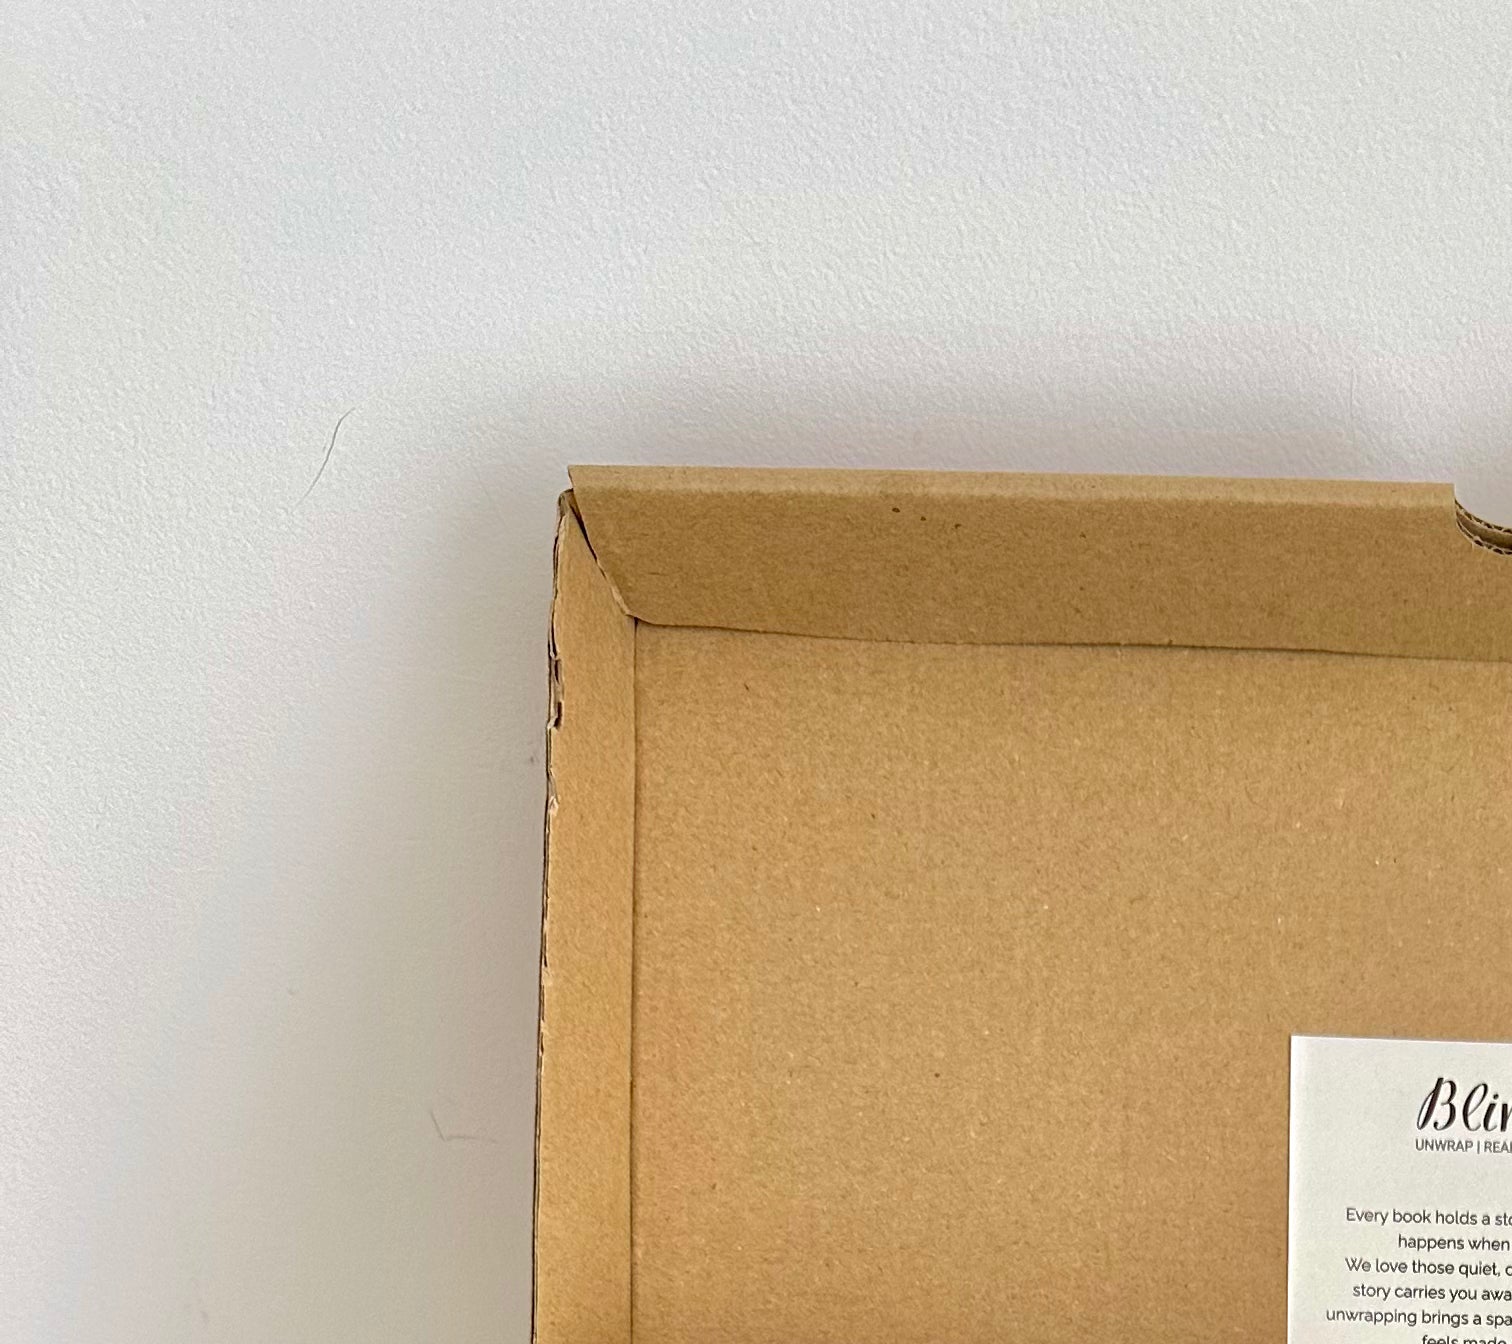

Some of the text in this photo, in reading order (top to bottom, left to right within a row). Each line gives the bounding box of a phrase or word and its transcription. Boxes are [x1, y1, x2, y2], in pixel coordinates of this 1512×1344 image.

[1415, 1138, 1474, 1153] UNWRAP
[1346, 1206, 1389, 1225] Every
[1392, 1208, 1432, 1224] book
[1435, 1209, 1478, 1226] holds
[1481, 1214, 1491, 1226] a
[1397, 1234, 1465, 1254] happens
[1467, 1235, 1511, 1252] when
[1344, 1256, 1372, 1273] We
[1375, 1257, 1409, 1274] love
[1411, 1258, 1455, 1275] those
[1458, 1260, 1501, 1280] quiet,
[1352, 1283, 1392, 1303] story
[1394, 1284, 1446, 1300] carries
[1448, 1287, 1478, 1304] you
[1325, 1307, 1418, 1327] unwrapping
[1421, 1309, 1470, 1329] brings
[1472, 1314, 1482, 1327] a
